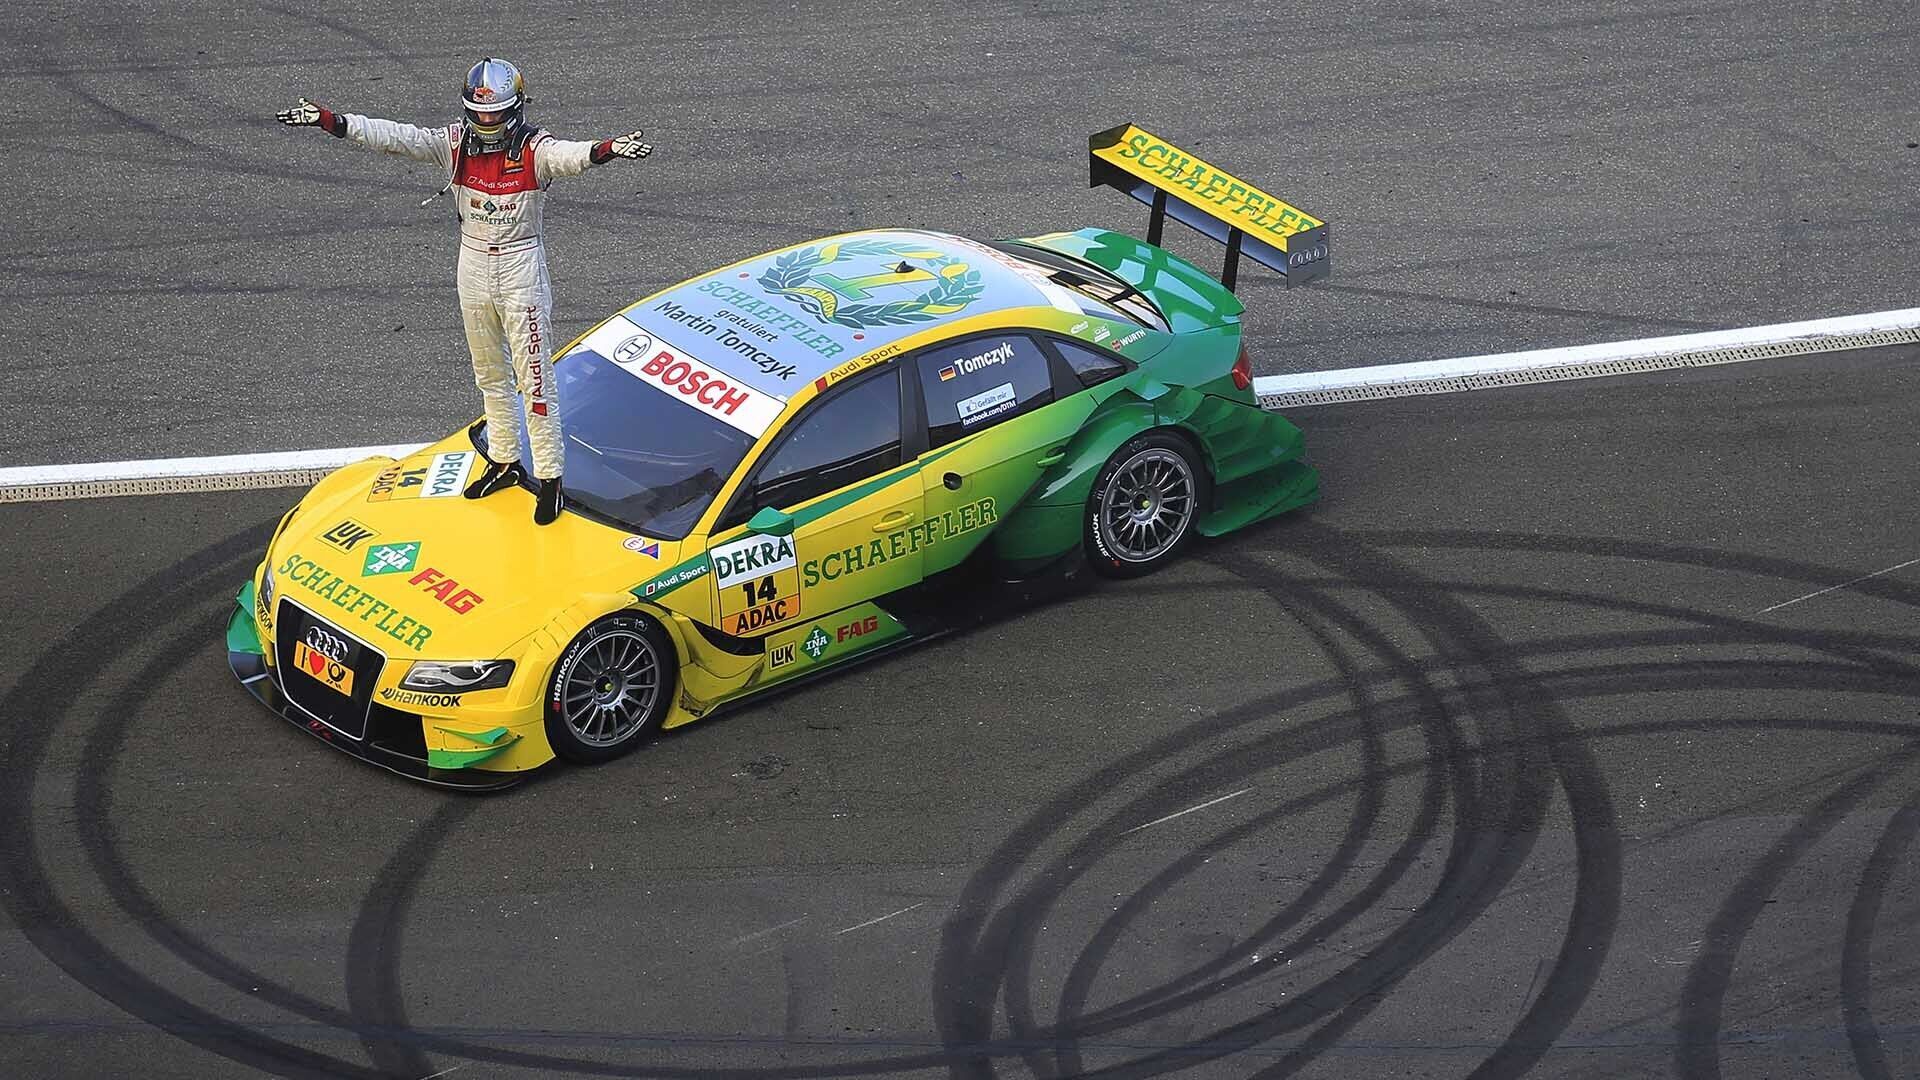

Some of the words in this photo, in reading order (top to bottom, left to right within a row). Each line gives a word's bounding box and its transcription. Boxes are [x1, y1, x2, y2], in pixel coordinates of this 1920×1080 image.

[478, 179, 495, 189] Audi
[497, 180, 519, 189] Sport
[1118, 134, 1317, 237] SCHAEFFLER
[470, 213, 517, 225] SCHAEFFLER
[499, 203, 517, 212] FAG
[526, 305, 542, 355] Sport
[697, 280, 845, 359] SCHAEFFLER
[713, 308, 779, 343] gratuliert
[653, 301, 718, 336] Martin
[716, 328, 797, 381] Tomczyk
[954, 342, 1014, 376] Tomczyk
[529, 359, 542, 398] Audi
[829, 360, 861, 381] Audi
[860, 344, 902, 365] Sport
[641, 350, 750, 416] BOSCH
[962, 399, 1017, 426] facebook.com/DTM
[397, 467, 428, 488] 14
[430, 452, 466, 496] DEKRA
[714, 536, 794, 580] DEKRA
[803, 496, 998, 588] SCHAEFFLER
[407, 567, 484, 615] FAG
[657, 575, 678, 590] Audi
[679, 565, 706, 580] Sport
[742, 575, 777, 608] 14
[278, 554, 433, 652] SCHAEFFLER
[735, 600, 787, 633] ADAC
[836, 615, 879, 643] FAG
